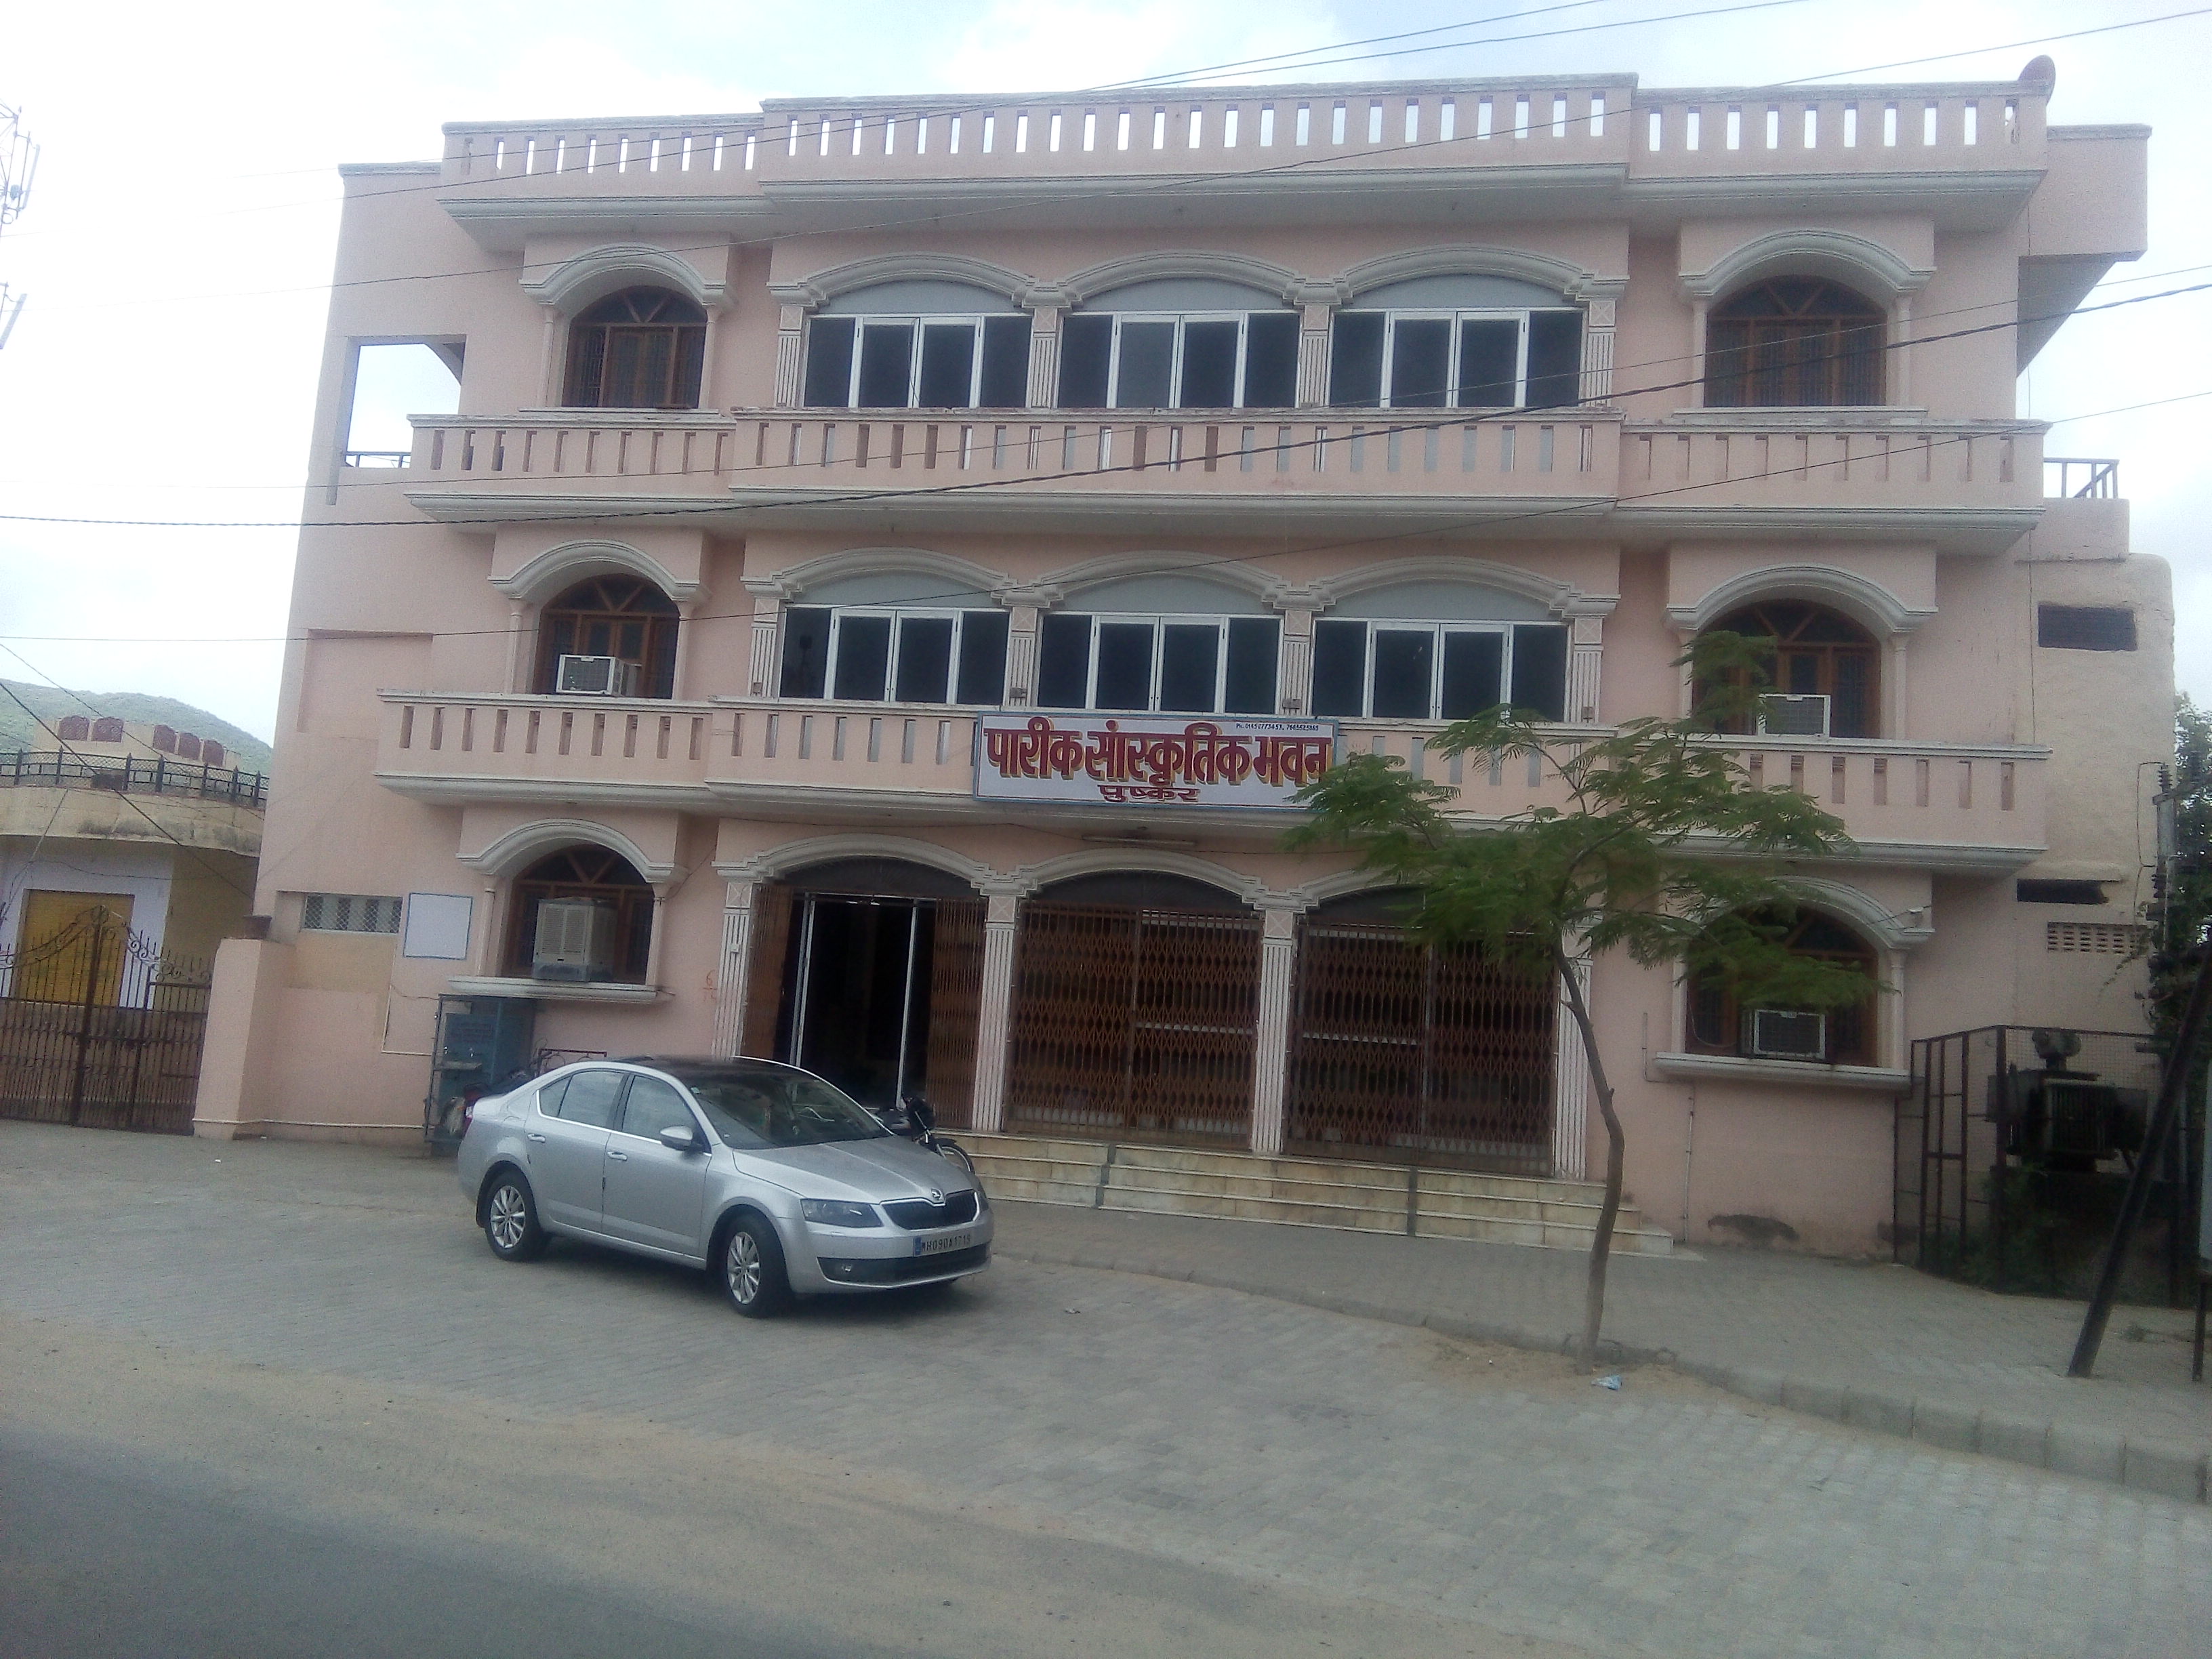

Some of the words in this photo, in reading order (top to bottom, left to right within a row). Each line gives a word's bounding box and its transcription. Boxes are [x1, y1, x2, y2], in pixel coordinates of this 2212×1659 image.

[983, 716, 1084, 780] पारीक
[1085, 720, 1253, 787] सांस्कृतिक
[1253, 736, 1334, 787] भवन
[1097, 784, 1201, 803] पुष्कर
